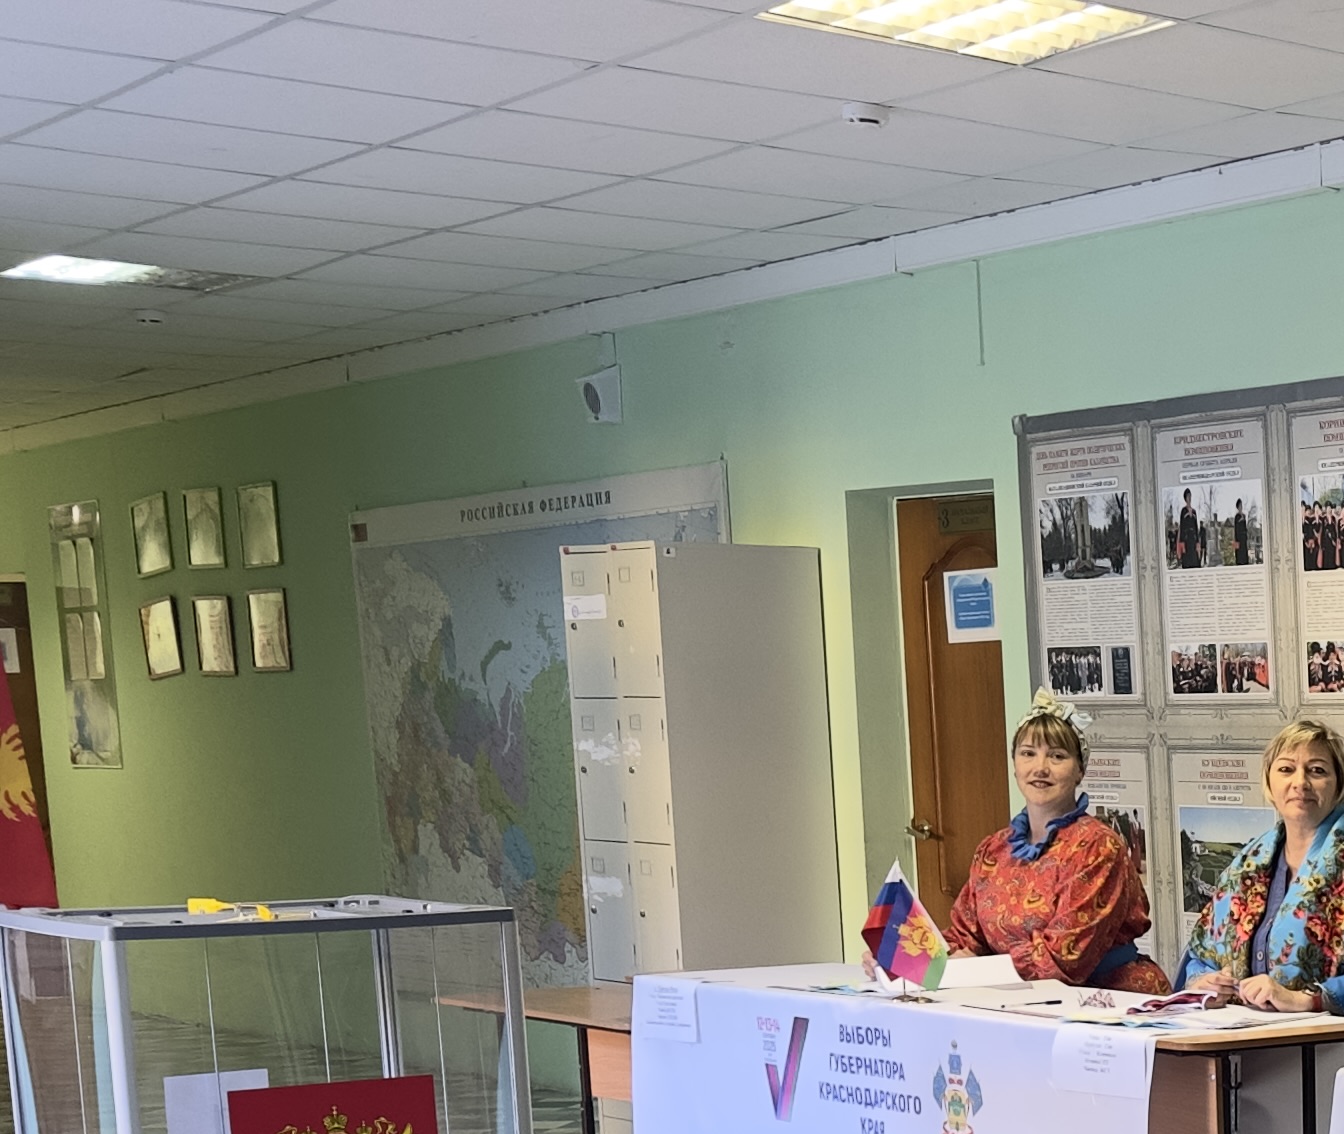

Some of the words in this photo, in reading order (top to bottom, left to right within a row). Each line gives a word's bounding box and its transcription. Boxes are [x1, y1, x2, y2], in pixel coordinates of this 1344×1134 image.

[460, 501, 534, 522] РОССИЙСКАЯ
[539, 490, 611, 513] ФЕДЕРАЦИЯ
[839, 1024, 891, 1048] ВЫБОРЫ
[829, 1052, 906, 1082] ГУБЕРНАТОРА
[818, 1081, 922, 1115] КРАСНОДАРСКОГО
